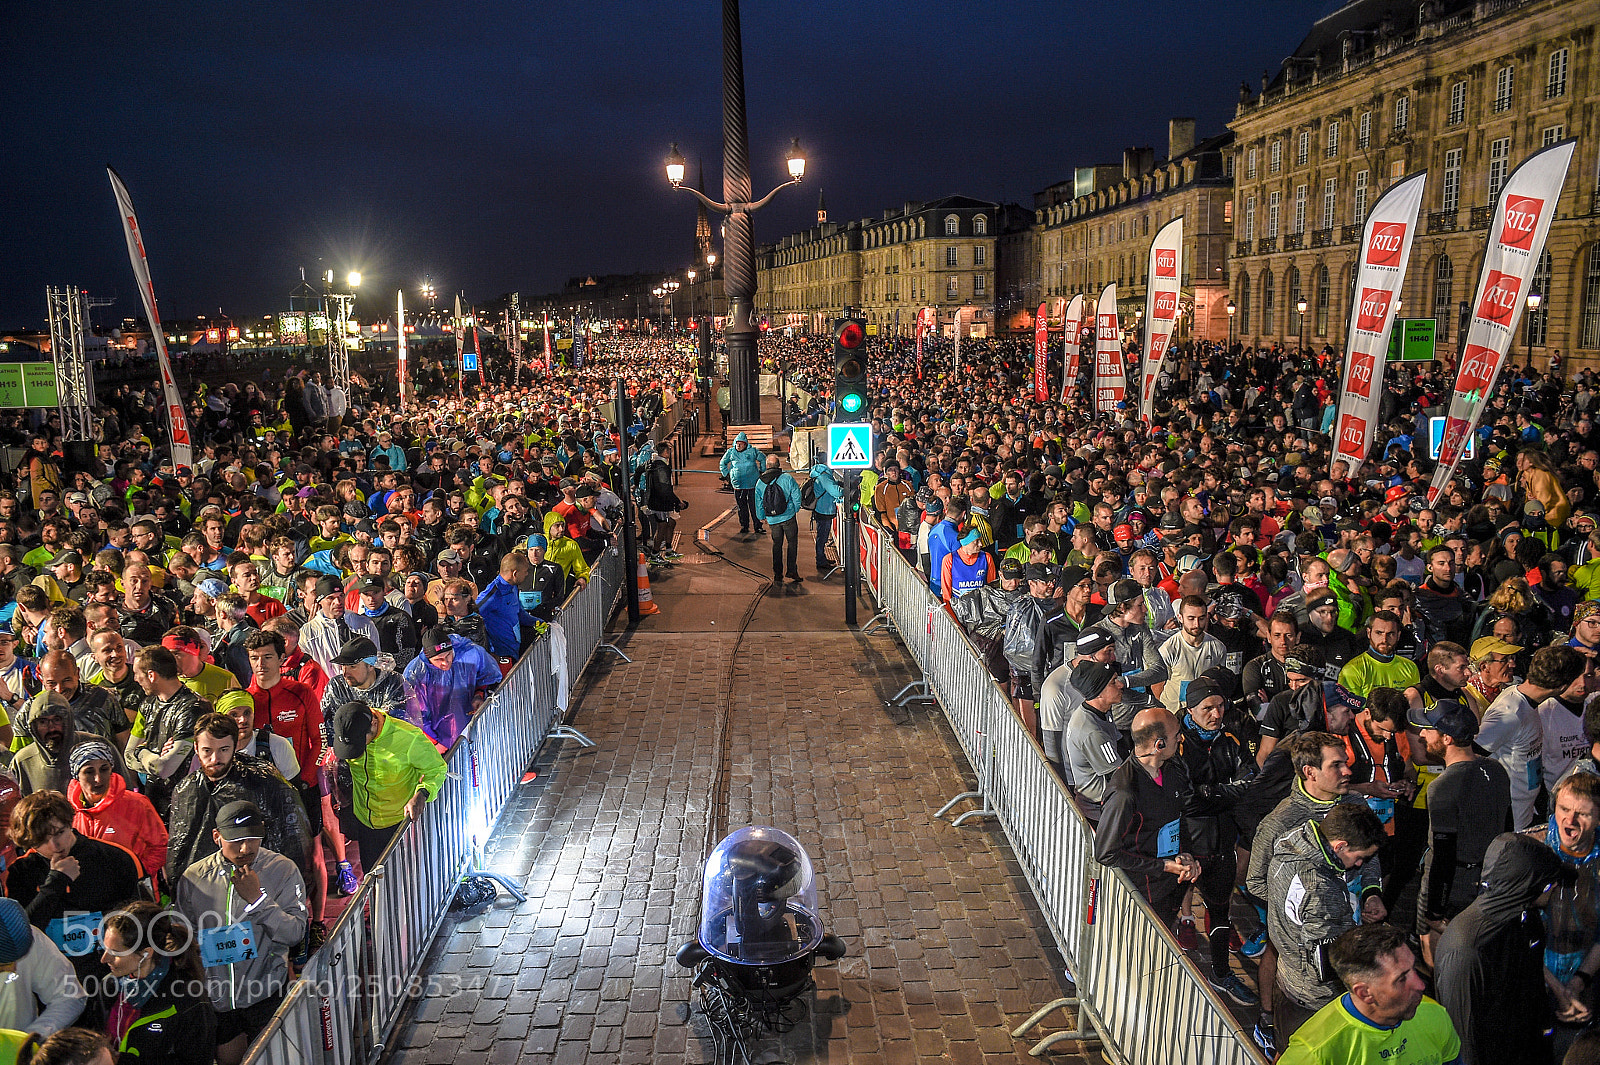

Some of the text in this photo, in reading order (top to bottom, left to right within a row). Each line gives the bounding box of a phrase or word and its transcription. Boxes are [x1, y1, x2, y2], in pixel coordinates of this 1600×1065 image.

[1506, 210, 1536, 232] RTL2
[1371, 234, 1401, 252] RTL2
[1157, 257, 1175, 268] RTL2
[1156, 299, 1175, 311] RTL2
[1361, 300, 1387, 318] RTL2
[1099, 389, 1115, 401] SUD
[1099, 400, 1118, 412] OUES
[315, 721, 328, 766] FINISHER
[1560, 734, 1579, 742] ÉQUIPE
[63, 930, 86, 942] 13047
